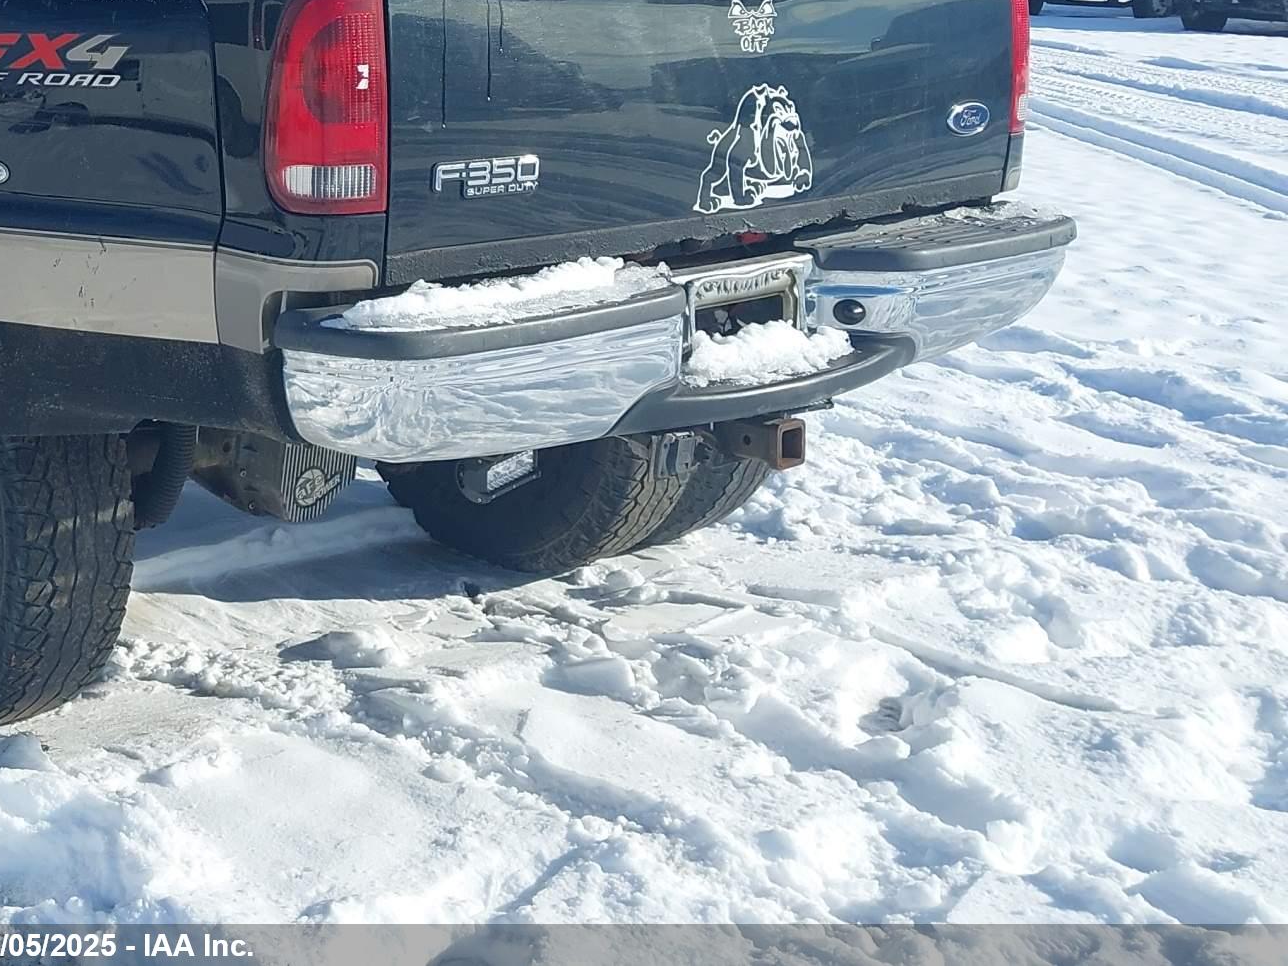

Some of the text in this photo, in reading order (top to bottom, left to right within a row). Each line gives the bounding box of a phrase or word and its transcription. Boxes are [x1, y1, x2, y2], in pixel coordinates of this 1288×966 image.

[732, 17, 775, 36] BACK
[740, 34, 770, 53] OFF
[16, 72, 122, 88] ROAD
[466, 180, 539, 196] SUPER DUTY
